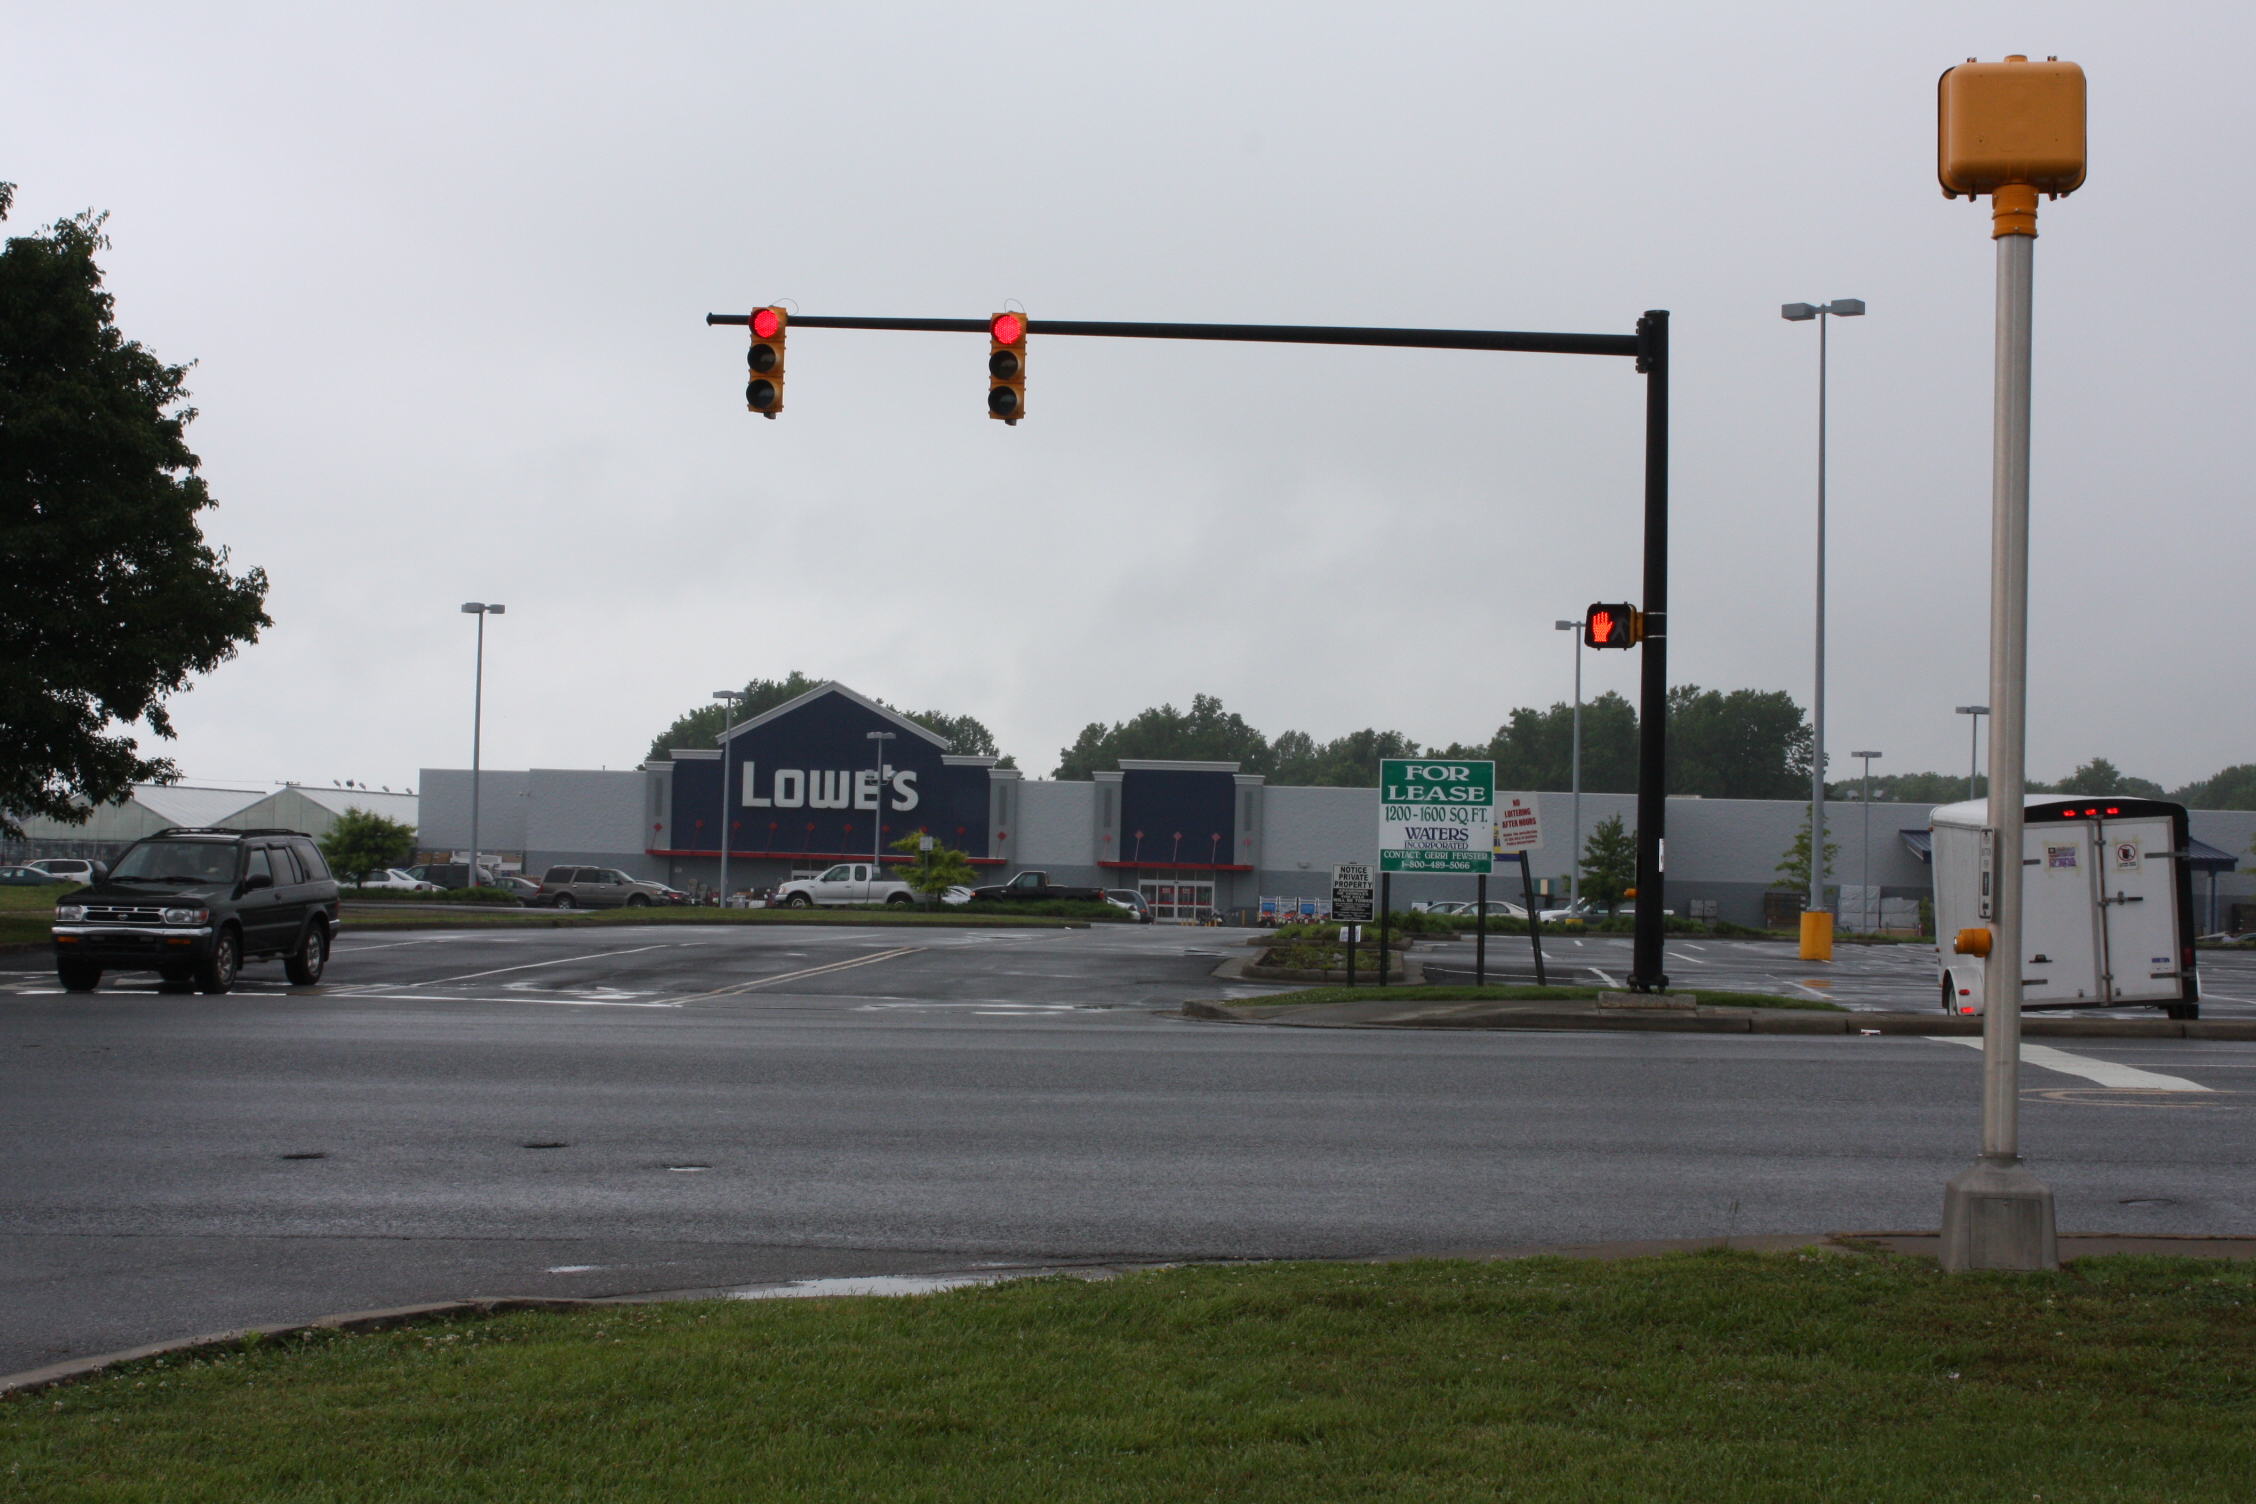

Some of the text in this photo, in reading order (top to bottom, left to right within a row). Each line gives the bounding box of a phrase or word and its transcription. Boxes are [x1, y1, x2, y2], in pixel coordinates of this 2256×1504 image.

[1405, 765, 1470, 781] FOR
[742, 761, 919, 812] LOWE'S
[1388, 785, 1486, 801] LEASE
[1512, 799, 1520, 807] NO
[1504, 808, 1531, 818] LOITERING
[1502, 817, 1536, 829] AFTER HOURS
[1405, 827, 1469, 840] WATERS
[1404, 841, 1469, 850] INCORPORATED
[1384, 850, 1488, 860] CONTACT: GERRI FEWSTER
[1401, 860, 1470, 869] 1-800-489-5066
[1340, 866, 1367, 874] NOTICE
